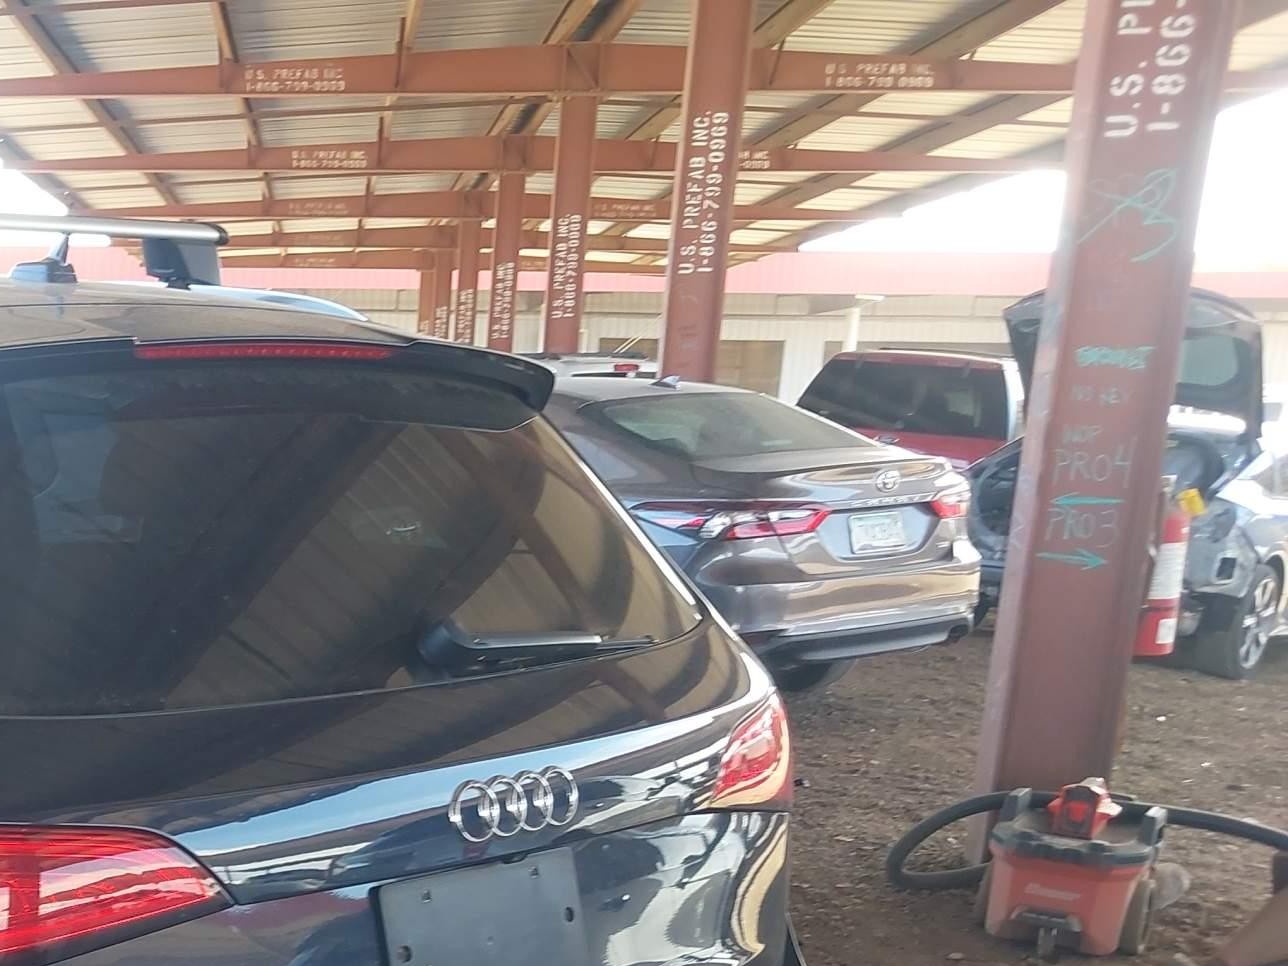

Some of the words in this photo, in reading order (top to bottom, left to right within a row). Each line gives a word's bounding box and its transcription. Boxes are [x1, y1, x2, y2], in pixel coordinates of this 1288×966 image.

[691, 111, 712, 147] INC.
[1104, 61, 1148, 137] U.S.
[682, 156, 706, 229] PREFAB
[696, 112, 729, 273] 1-866-799-0969
[677, 240, 698, 274] U.S.
